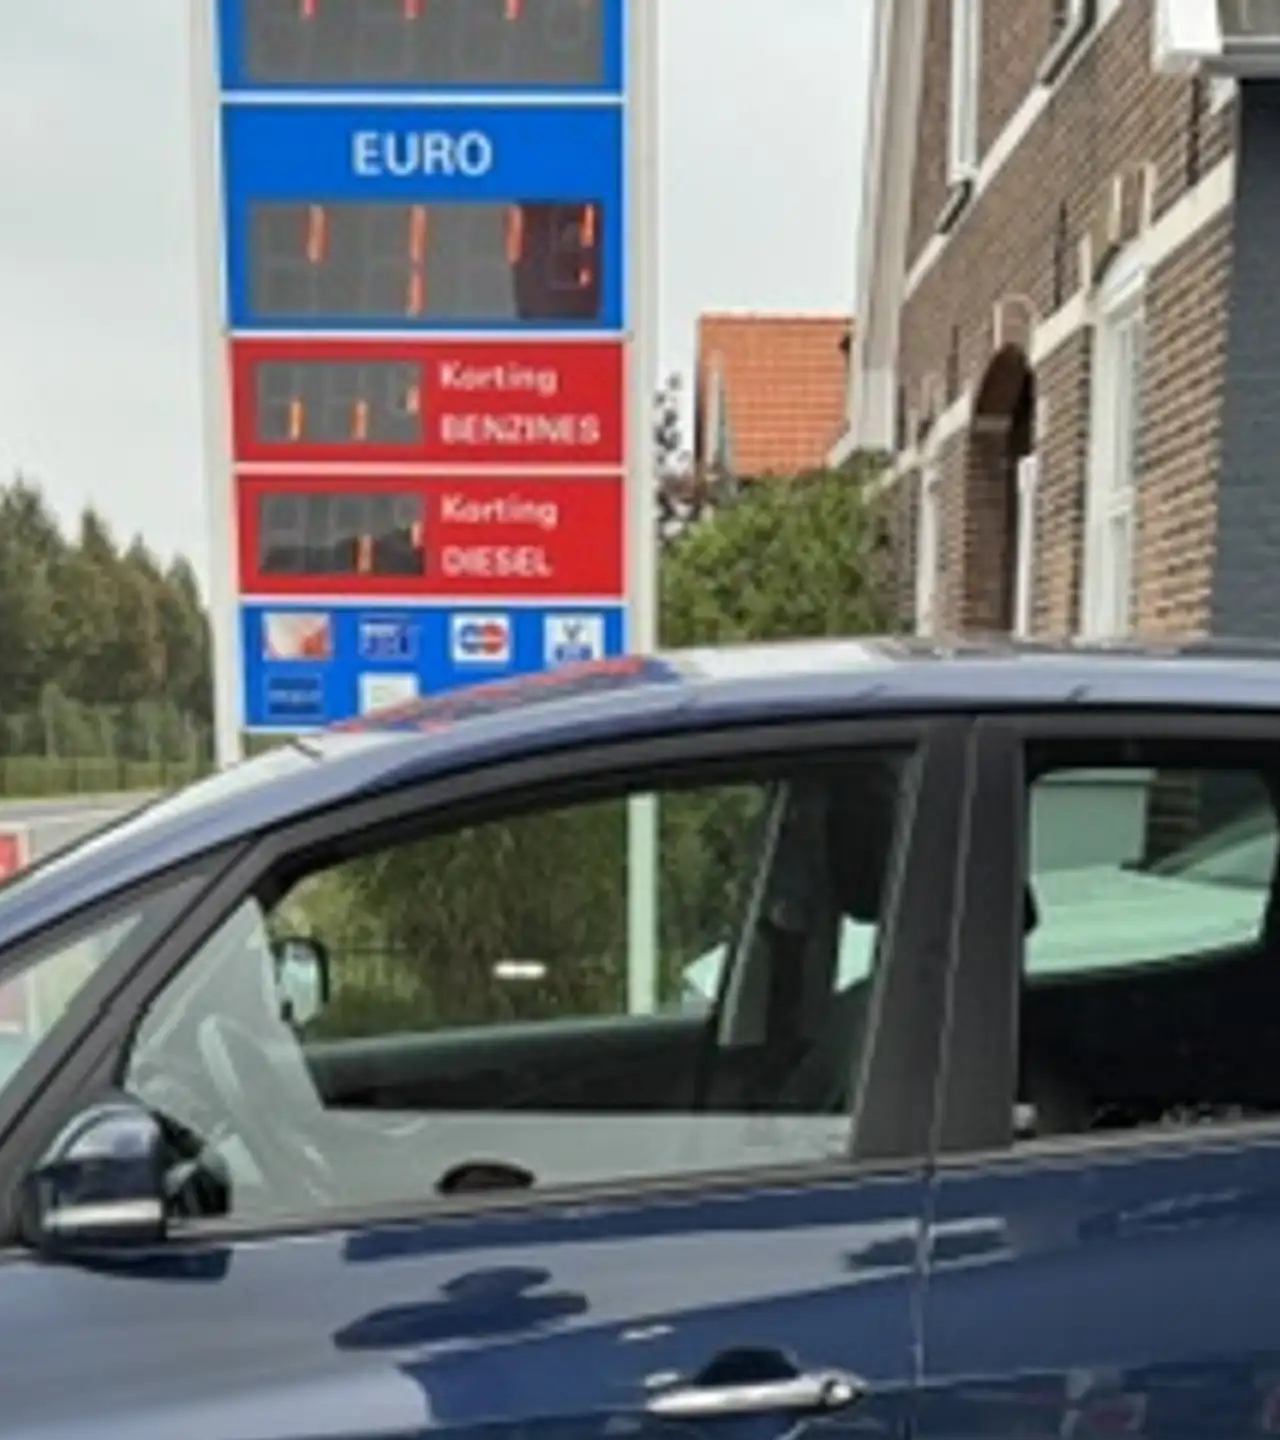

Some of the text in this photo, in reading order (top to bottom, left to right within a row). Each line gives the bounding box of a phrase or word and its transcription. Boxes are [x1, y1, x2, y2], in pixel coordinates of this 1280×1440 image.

[352, 129, 494, 177] EURO
[440, 362, 558, 397] Korting
[440, 413, 601, 445] BENZINES
[440, 493, 559, 531] Korting
[440, 545, 553, 578] DIESEL
